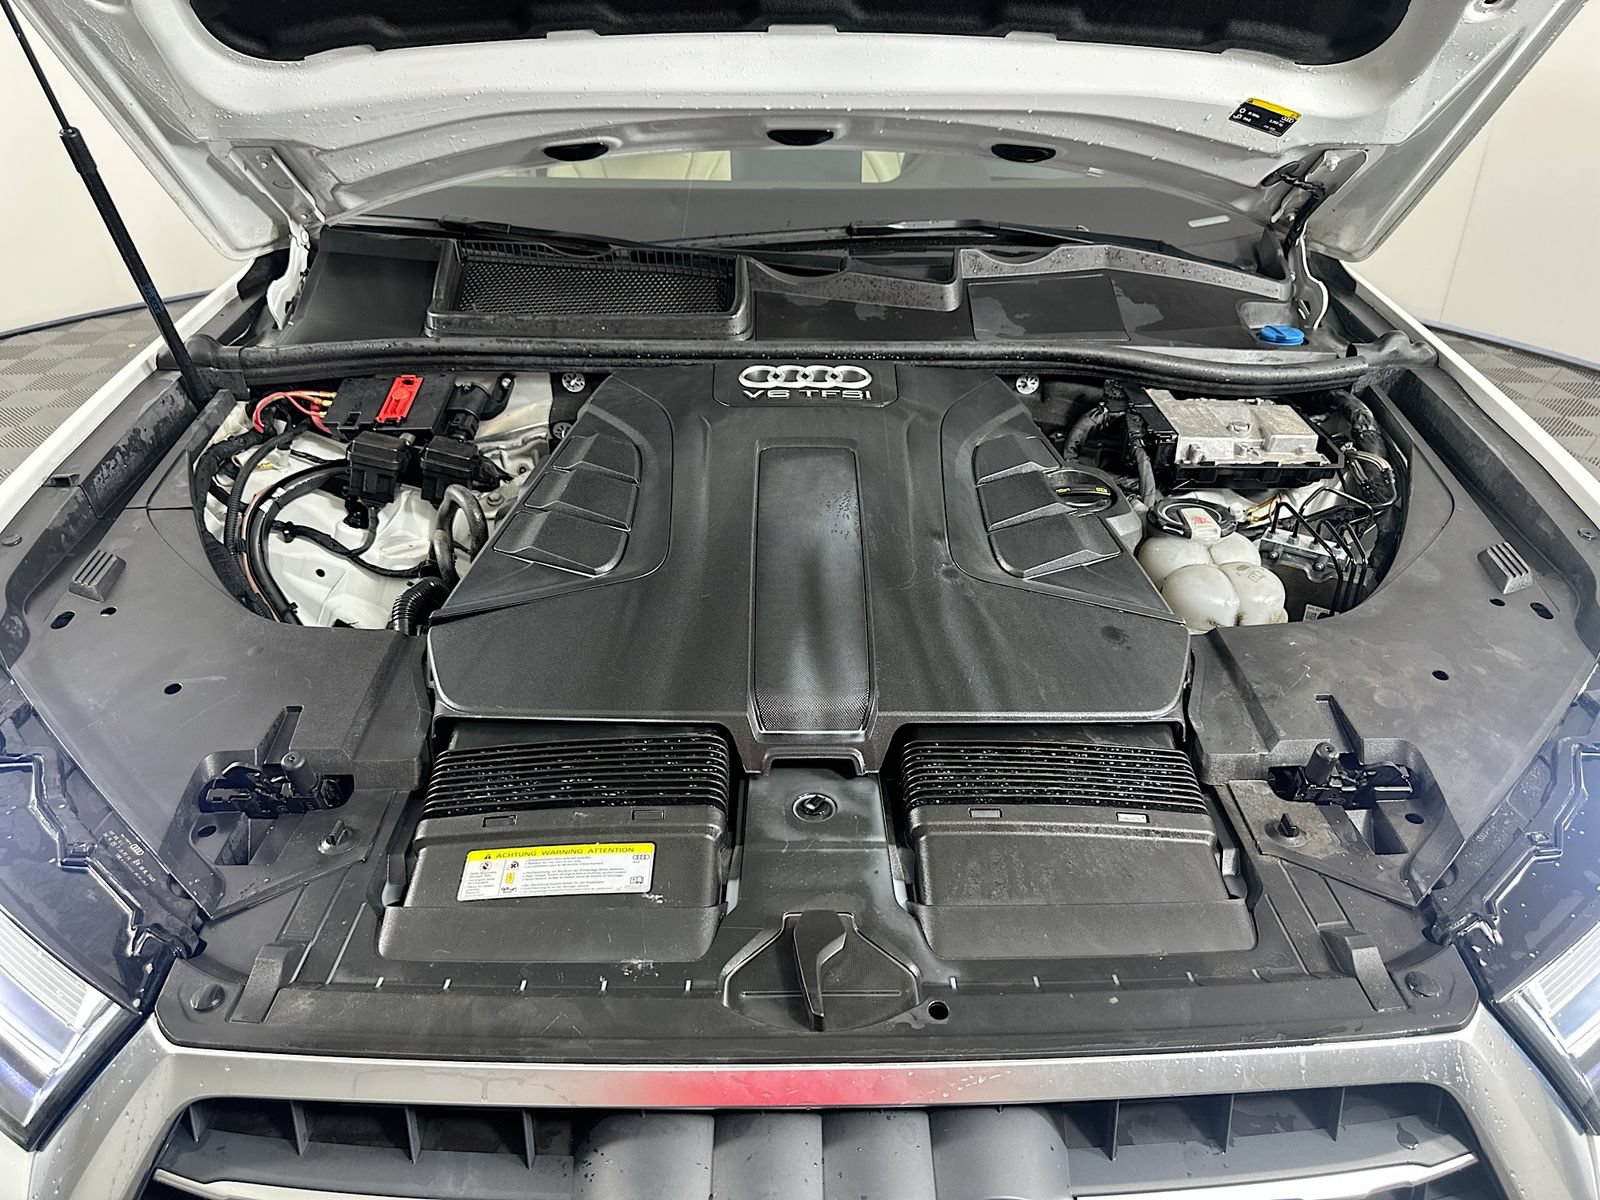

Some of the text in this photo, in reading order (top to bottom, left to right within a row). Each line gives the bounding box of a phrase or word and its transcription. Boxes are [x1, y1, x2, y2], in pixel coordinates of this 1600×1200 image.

[743, 389, 872, 400] V6 TFSI
[495, 846, 635, 859] ACHTUNG WARNING ATTENTION
